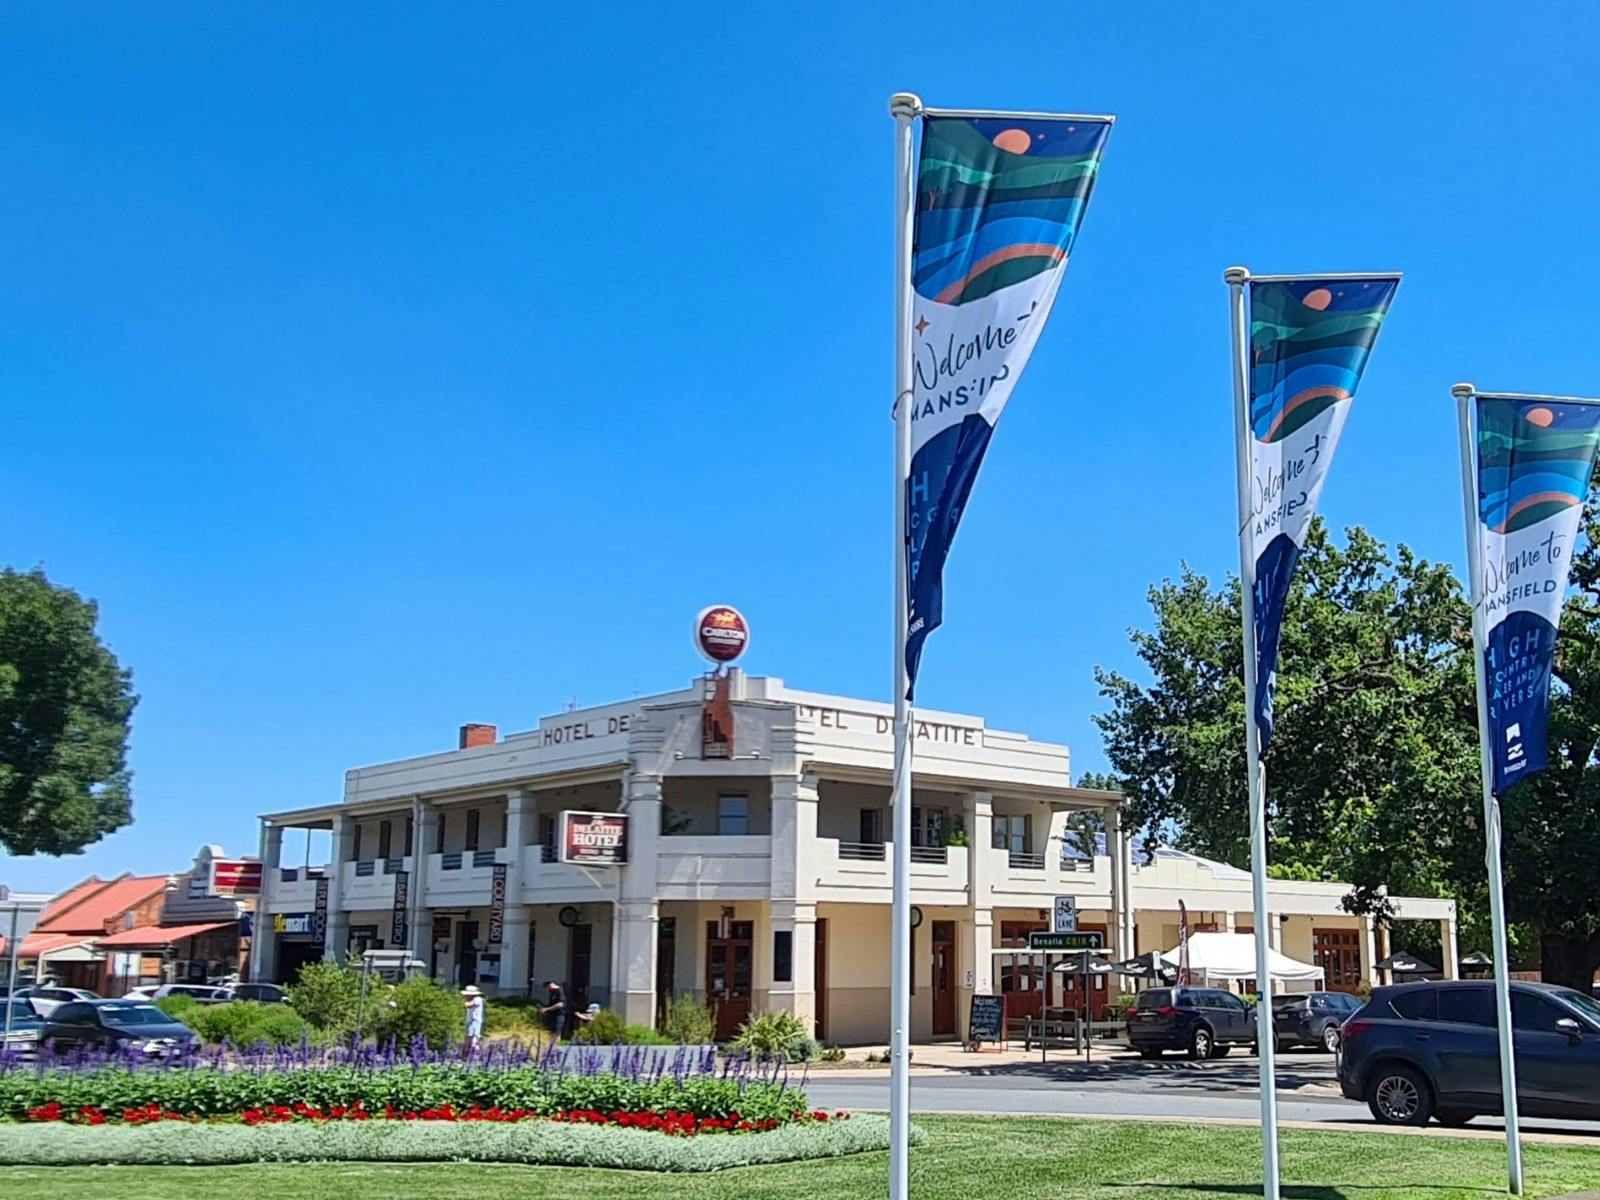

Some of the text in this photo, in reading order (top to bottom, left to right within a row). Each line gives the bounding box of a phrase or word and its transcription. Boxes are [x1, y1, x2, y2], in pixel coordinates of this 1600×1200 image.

[1540, 530, 1567, 565] to
[543, 722, 595, 747] HOTEL
[571, 833, 624, 847] HOTEL
[1058, 919, 1073, 929] LANE
[1033, 936, 1063, 946] Benalla
